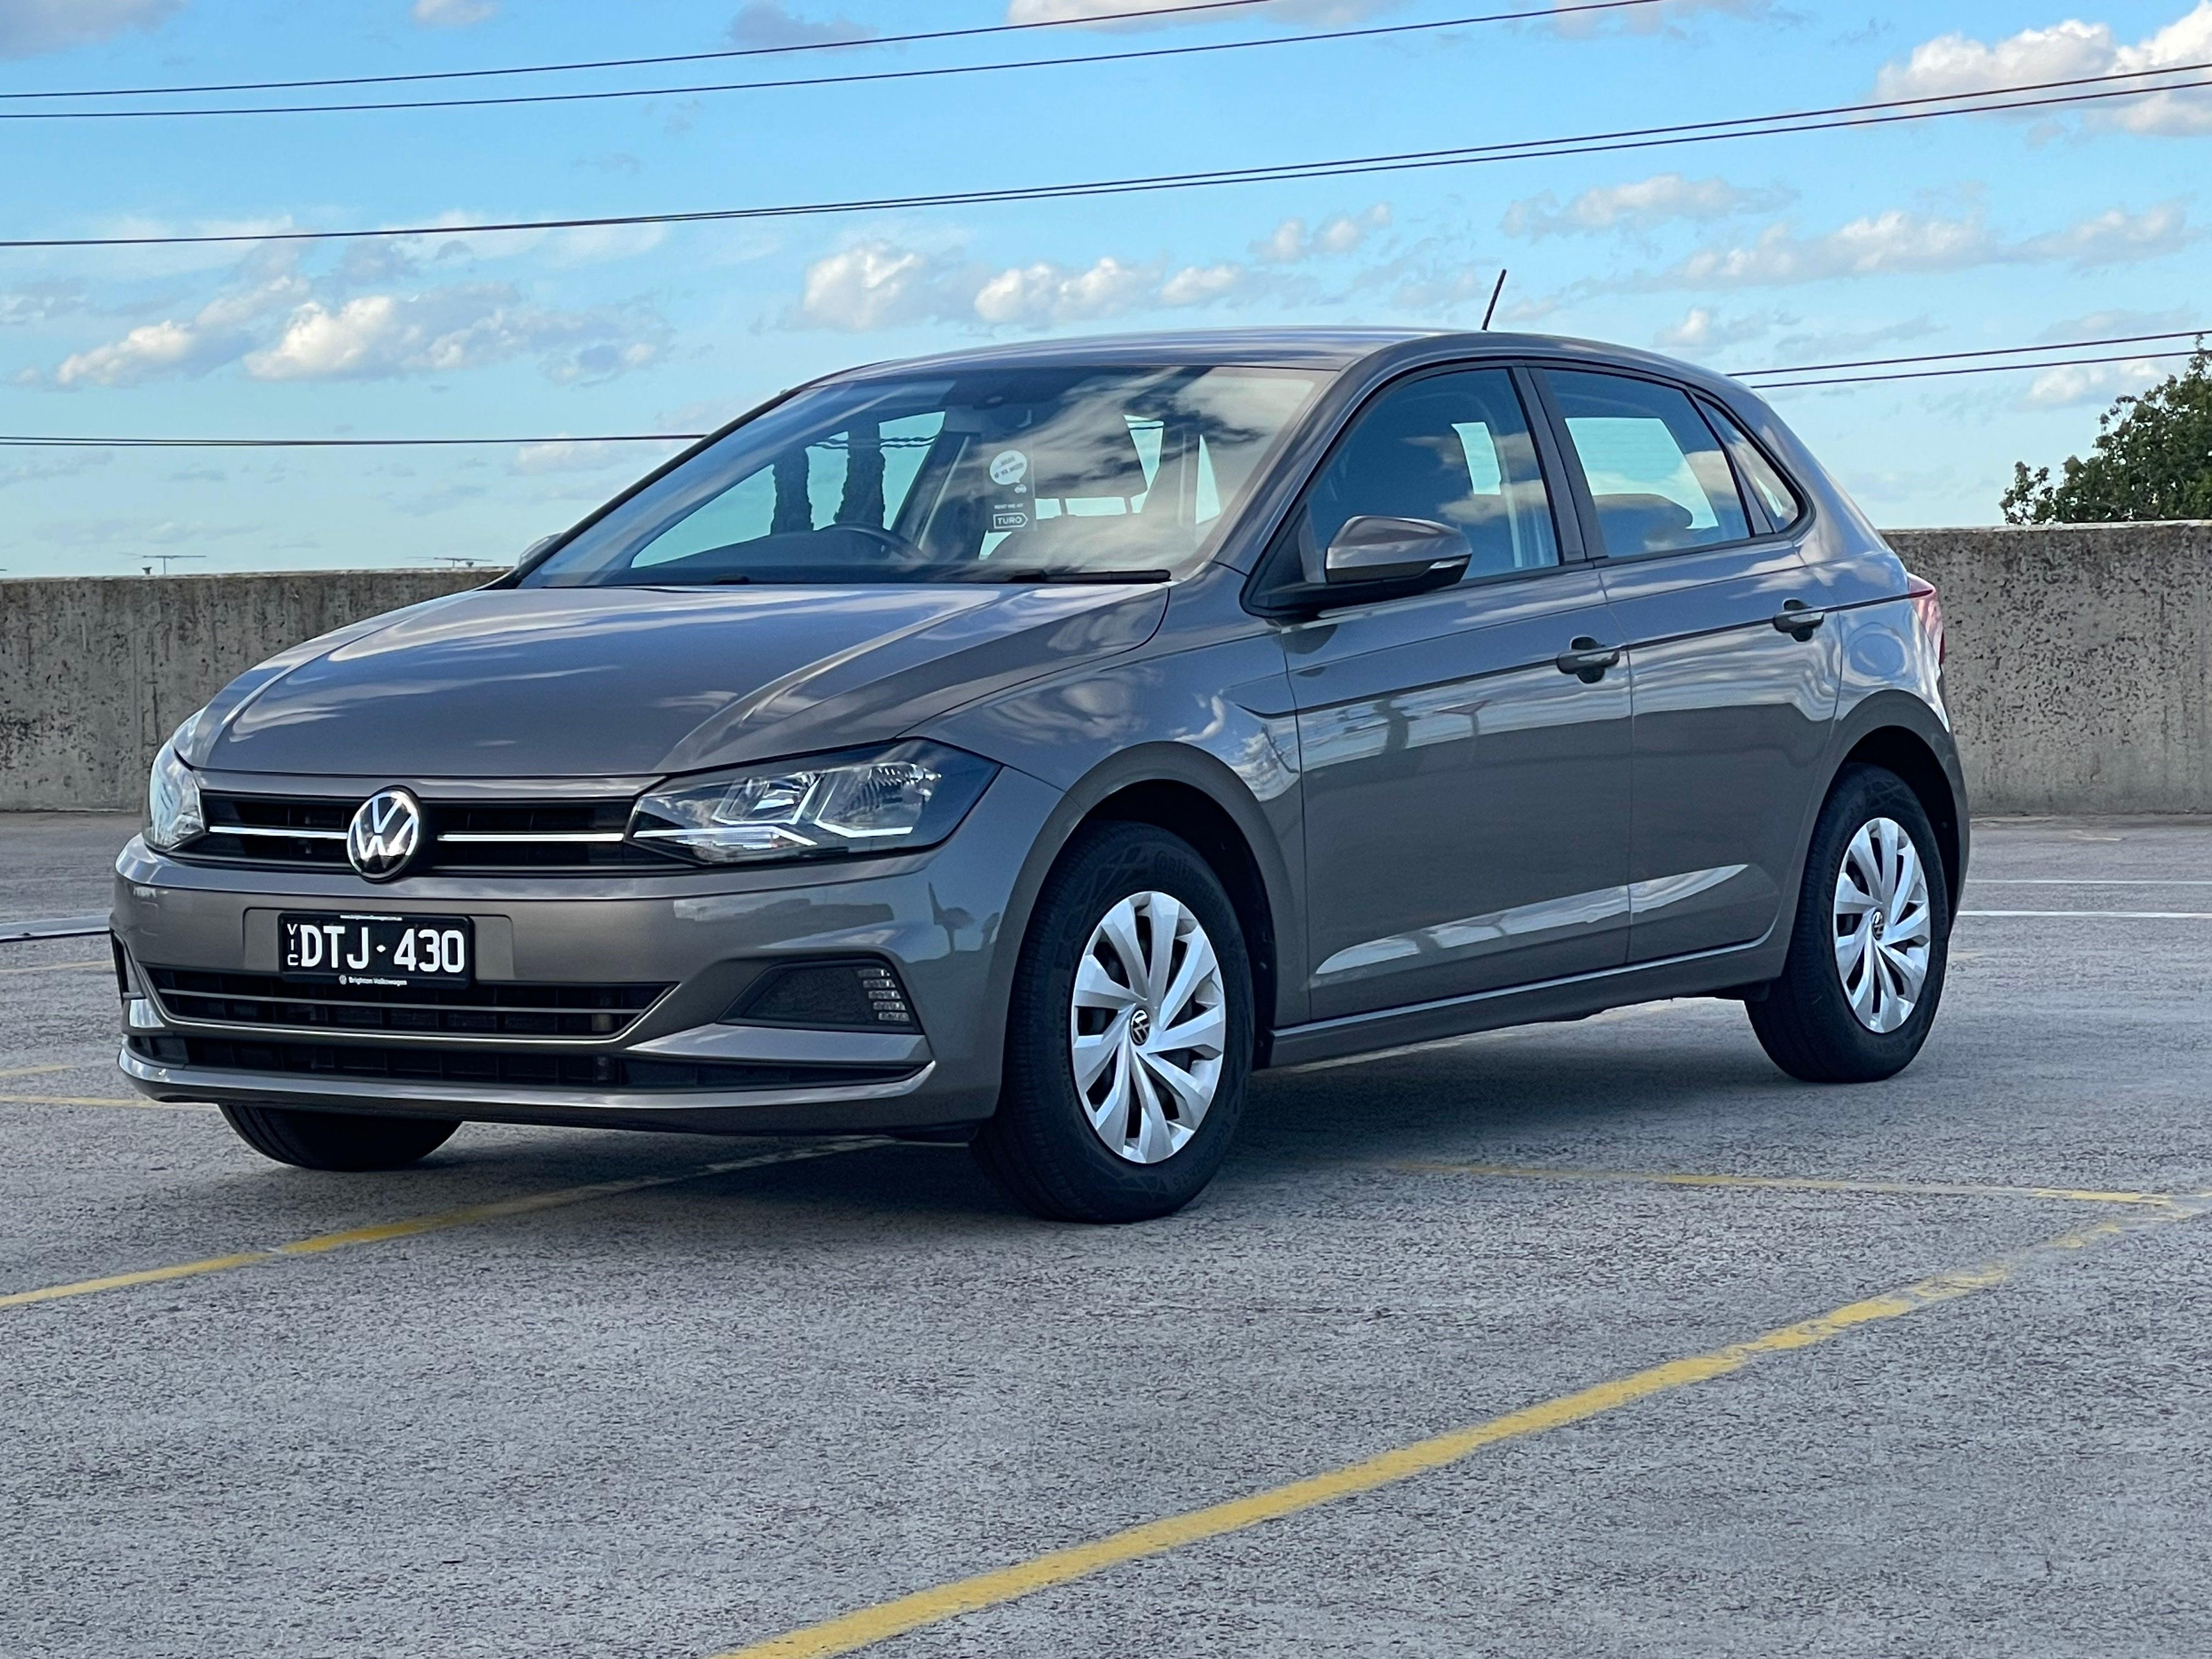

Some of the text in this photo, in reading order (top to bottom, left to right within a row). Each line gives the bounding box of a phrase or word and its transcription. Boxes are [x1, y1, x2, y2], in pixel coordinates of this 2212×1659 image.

[997, 516, 1023, 525] TURO
[350, 792, 417, 873] VW
[287, 923, 298, 966] VIC
